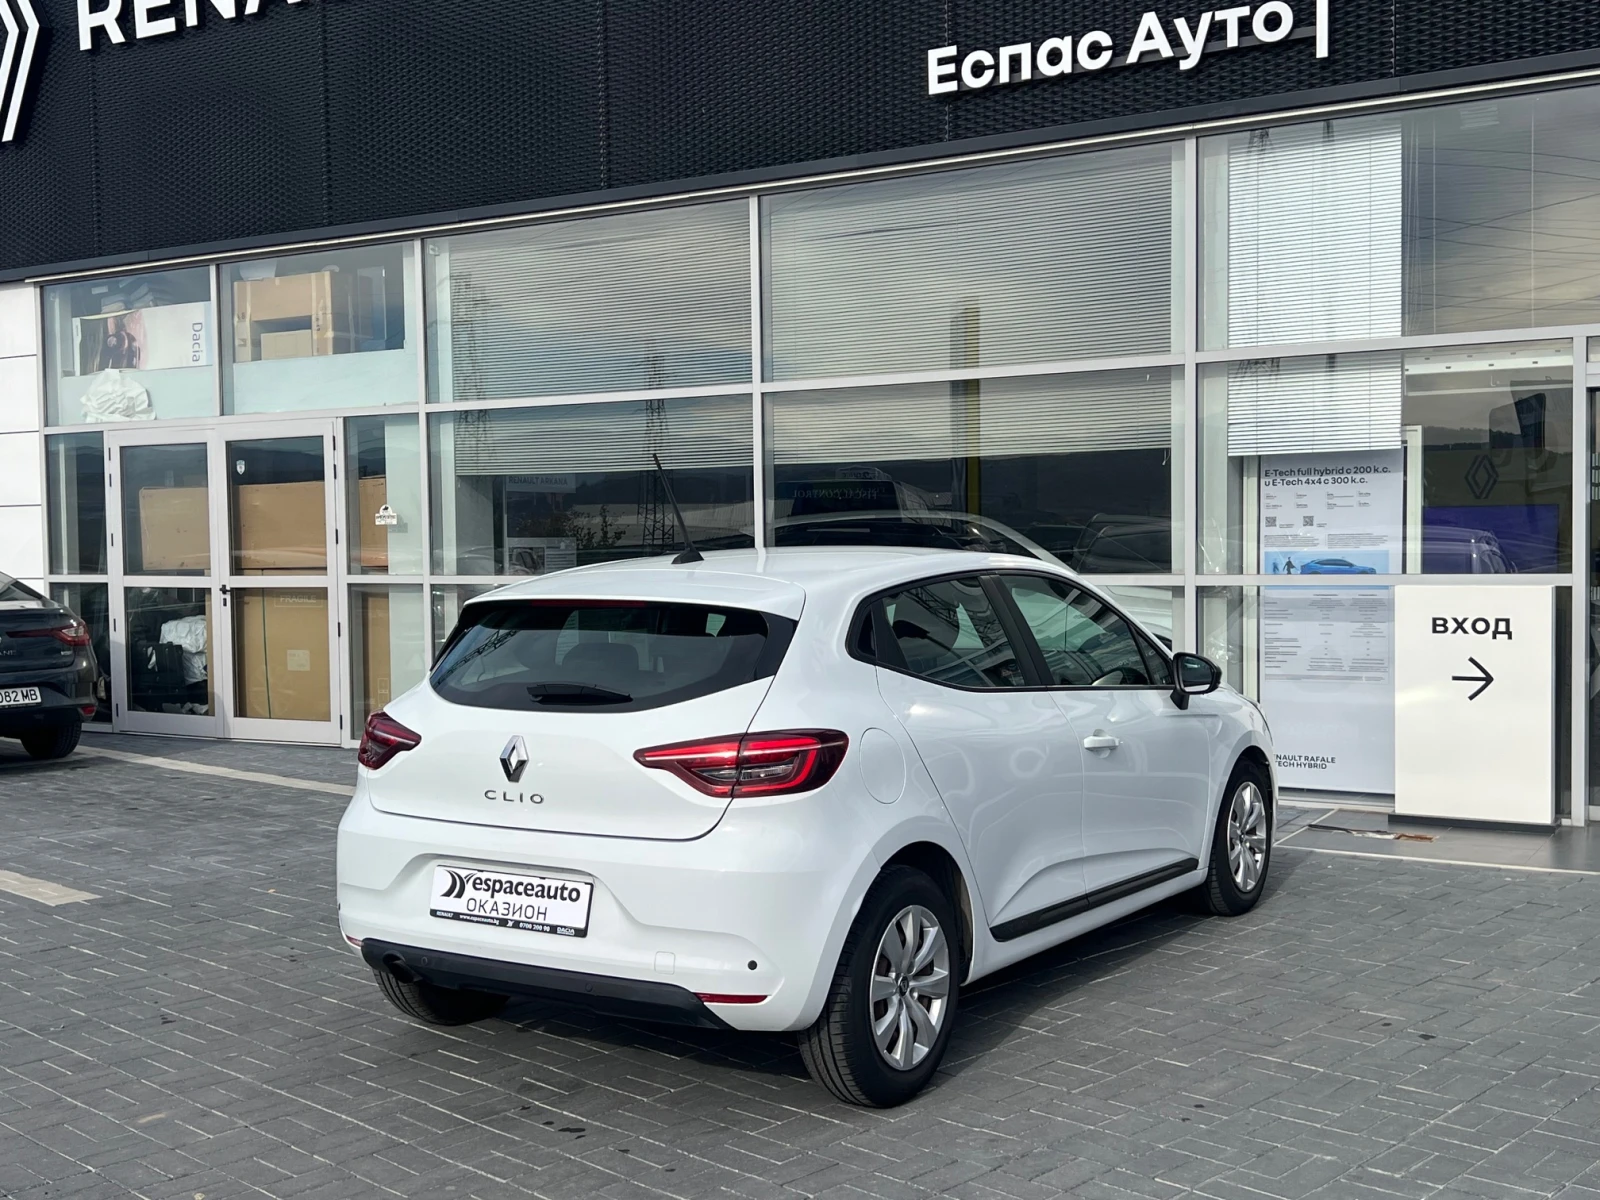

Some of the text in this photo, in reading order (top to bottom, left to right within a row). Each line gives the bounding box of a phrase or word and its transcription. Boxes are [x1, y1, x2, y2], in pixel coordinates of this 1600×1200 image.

[927, 1, 1294, 95] Еспас Ауто
[192, 322, 203, 362] Dacia
[1264, 468, 1296, 478] E-Tech
[1297, 467, 1312, 477] full
[1313, 466, 1345, 478] hybrid
[1353, 465, 1372, 475] 200
[1271, 477, 1303, 486] E-Tech
[1331, 476, 1349, 484] 300
[280, 594, 317, 603] FRAGILE
[1431, 616, 1513, 640] ВХОД
[1296, 761, 1328, 770] HYBRID
[1304, 755, 1336, 764] RAFALE
[484, 789, 544, 804] CLIO
[471, 876, 581, 903] espaceauto
[466, 897, 548, 922] ОКАЗИОН
